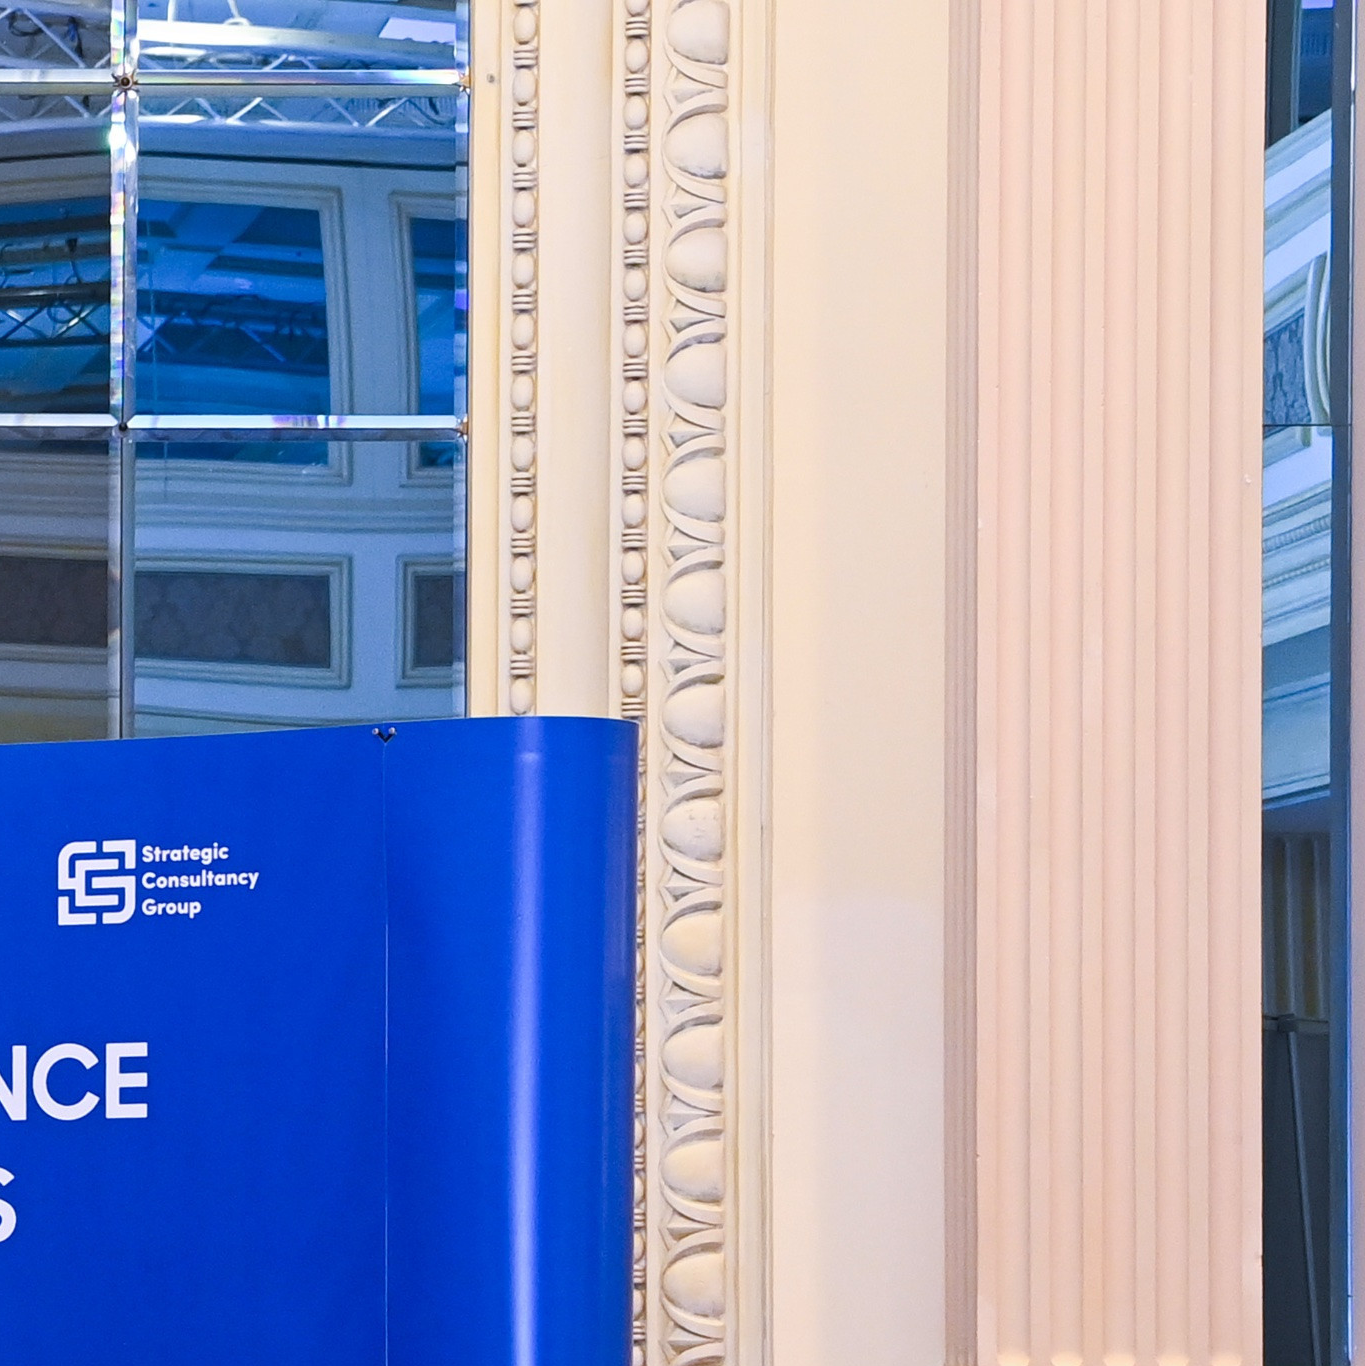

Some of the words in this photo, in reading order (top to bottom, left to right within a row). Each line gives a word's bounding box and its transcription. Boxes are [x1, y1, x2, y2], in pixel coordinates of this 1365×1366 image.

[142, 842, 229, 865] Strategic
[141, 869, 259, 890] Consultancy
[141, 898, 202, 919] Group
